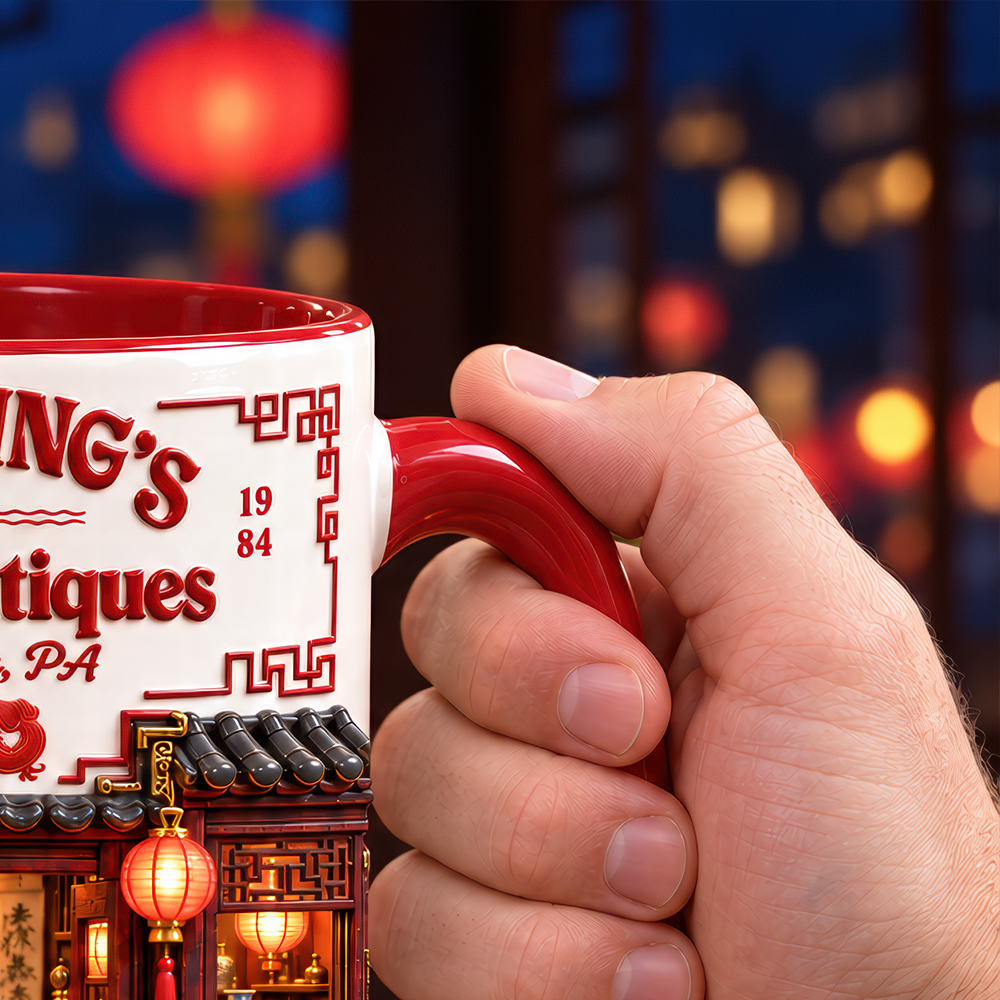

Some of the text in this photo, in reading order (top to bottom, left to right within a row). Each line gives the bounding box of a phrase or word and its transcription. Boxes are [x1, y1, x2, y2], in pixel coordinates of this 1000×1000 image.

[239, 485, 273, 517] 19
[236, 527, 273, 559] 84
[24, 639, 102, 682] PA
